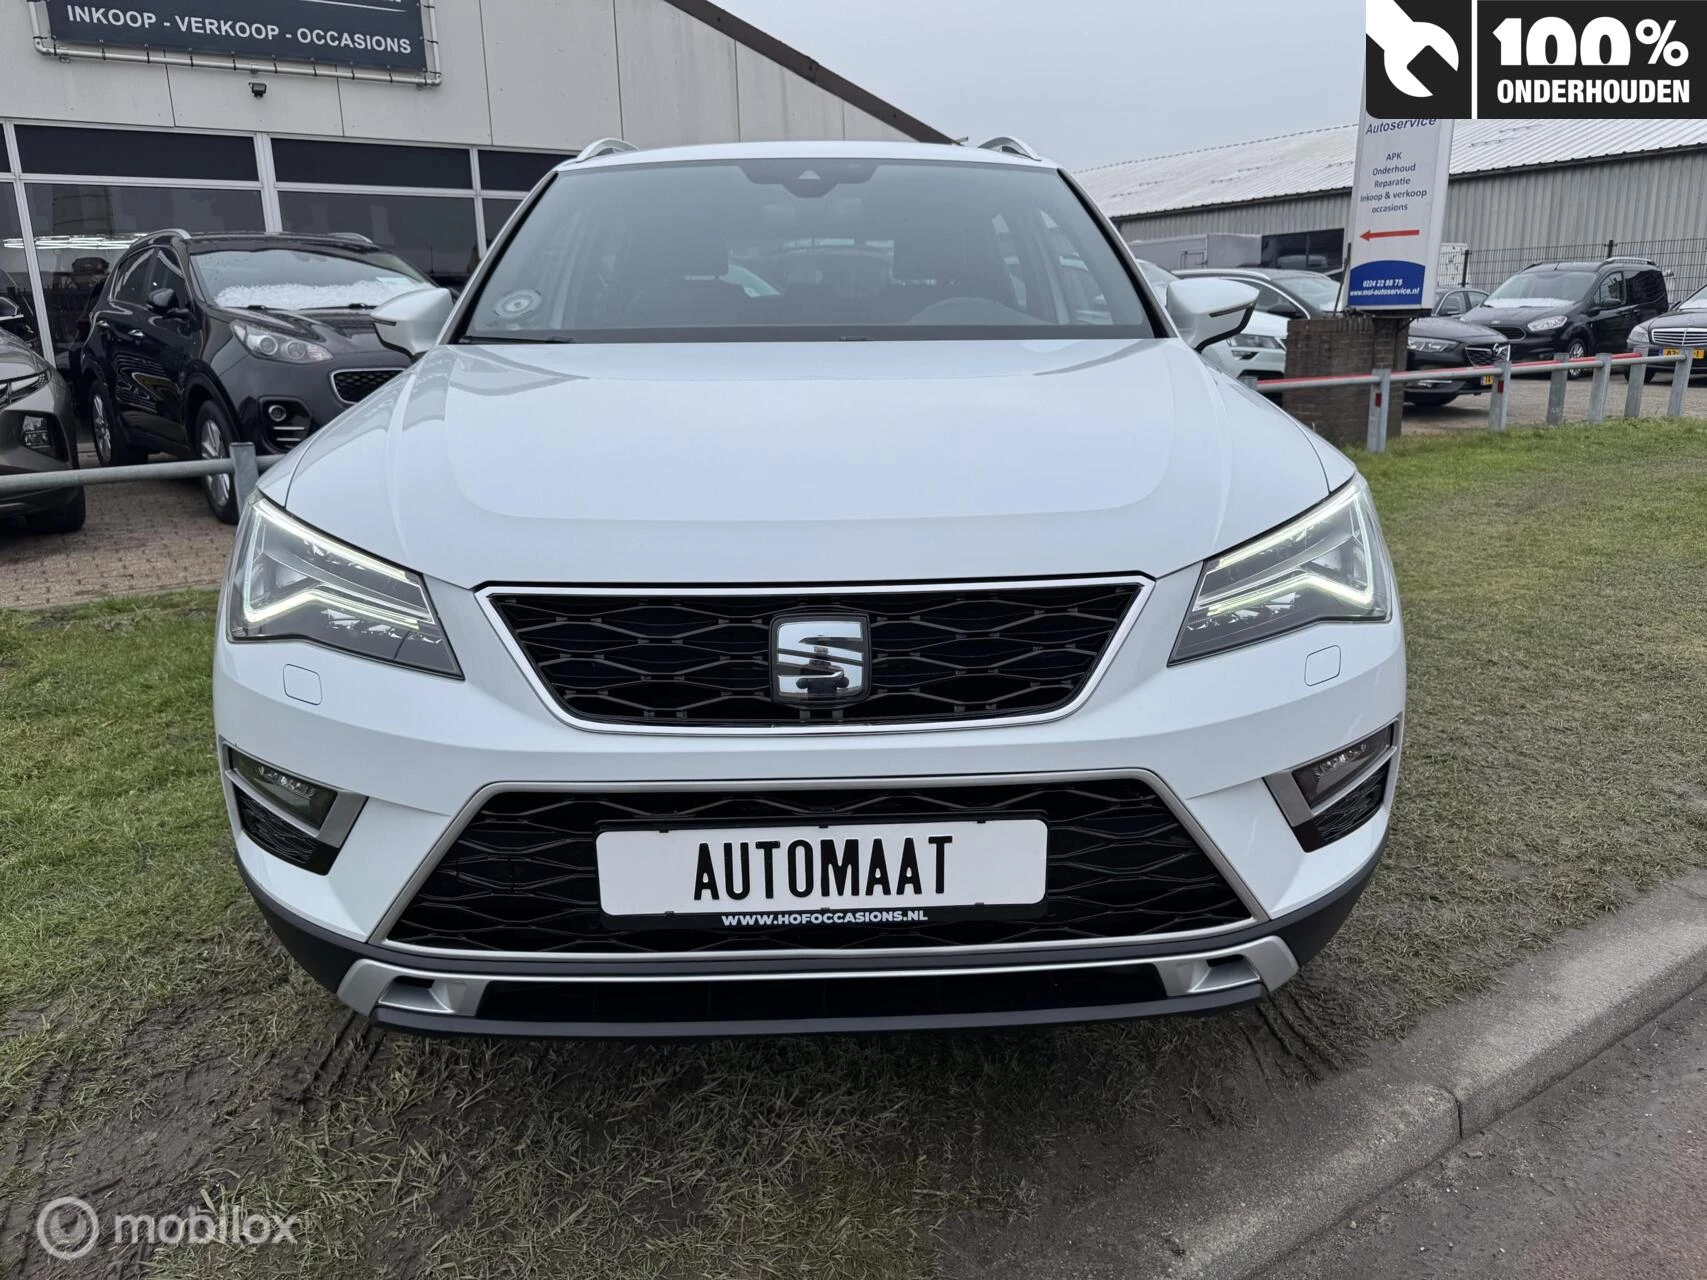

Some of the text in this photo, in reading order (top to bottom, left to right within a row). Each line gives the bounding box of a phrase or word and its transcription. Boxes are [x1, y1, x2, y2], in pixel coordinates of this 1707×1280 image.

[67, 4, 157, 29] INKOOP
[174, 16, 279, 41] VERKOOP
[297, 28, 411, 55] OCCASIONS
[1366, 119, 1436, 135] Autoservice
[1386, 152, 1402, 161] APK
[1372, 163, 1416, 175] Onderhoud
[1374, 177, 1411, 188] Reparatie
[1384, 191, 1391, 200] &
[1393, 190, 1427, 199] verkoop
[1371, 204, 1408, 213] occasions
[694, 836, 953, 900] AUTOMAAT
[722, 910, 928, 927] WWW.HOFOCCASIONS.NL
